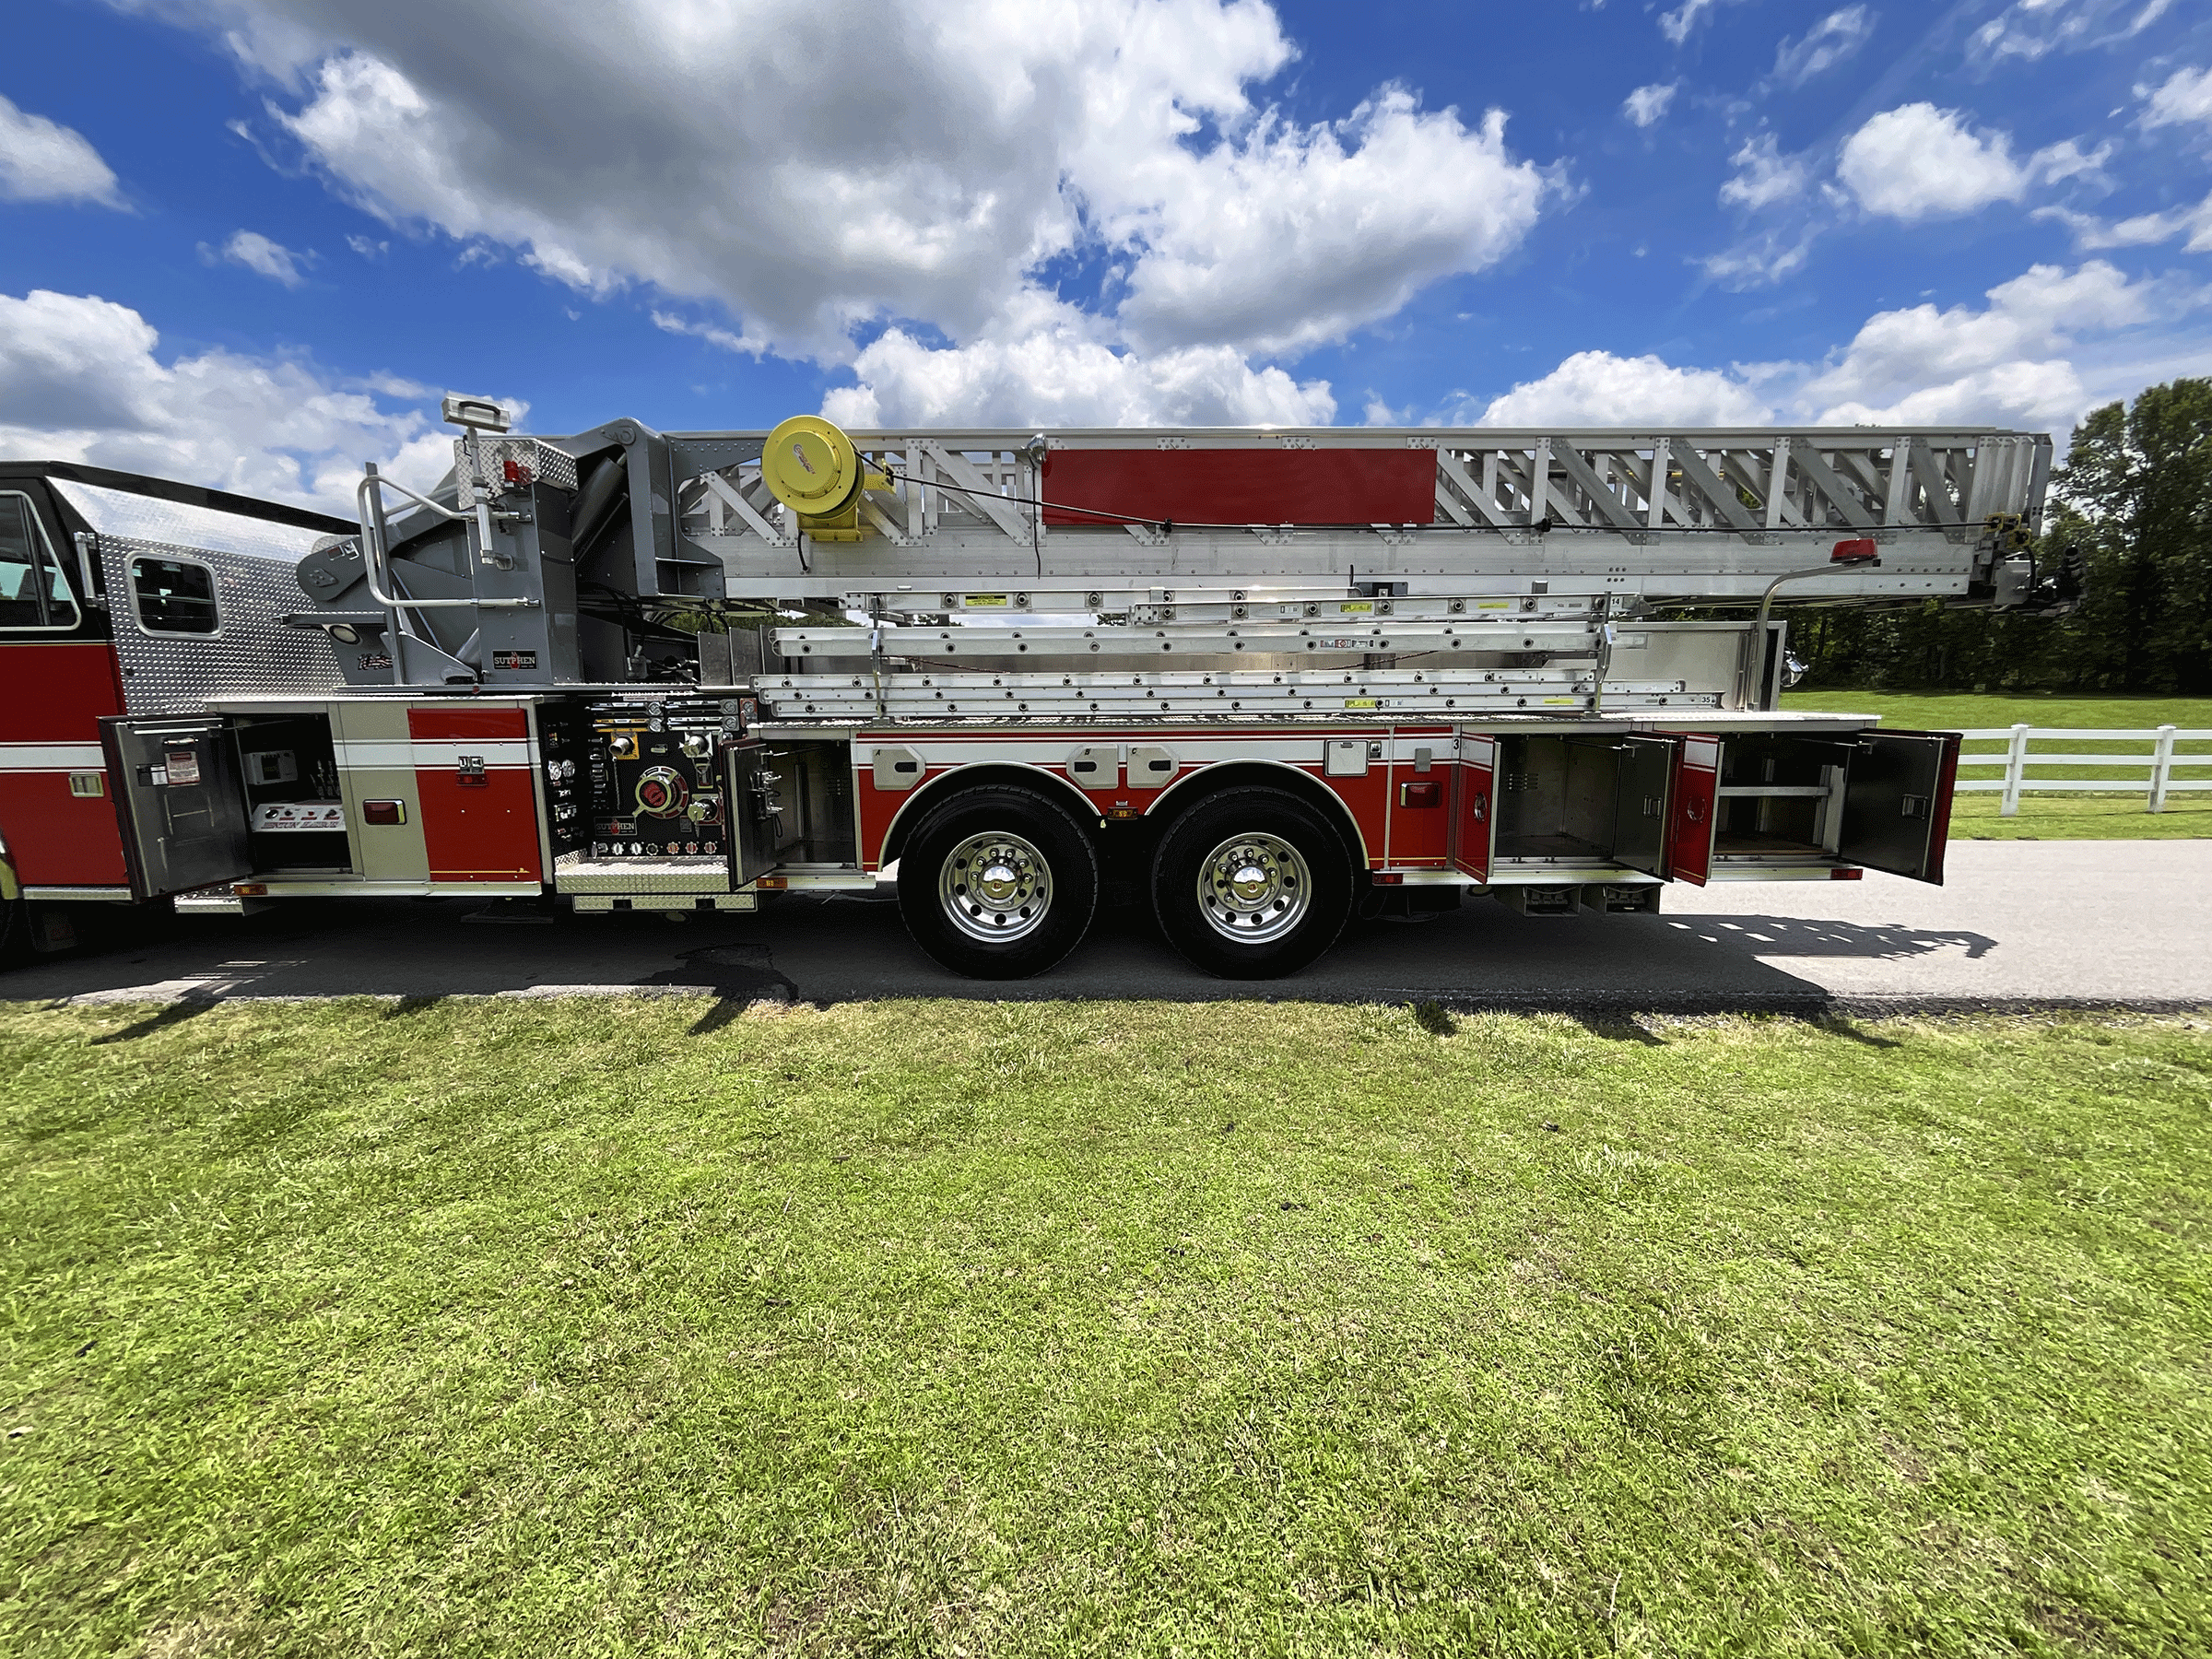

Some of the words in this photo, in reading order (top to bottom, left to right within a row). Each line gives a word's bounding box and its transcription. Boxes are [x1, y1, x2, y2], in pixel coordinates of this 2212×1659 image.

[494, 656, 535, 665] SUTPHEN
[1453, 738, 1460, 750] 3
[595, 822, 635, 830] SUTPHEN
